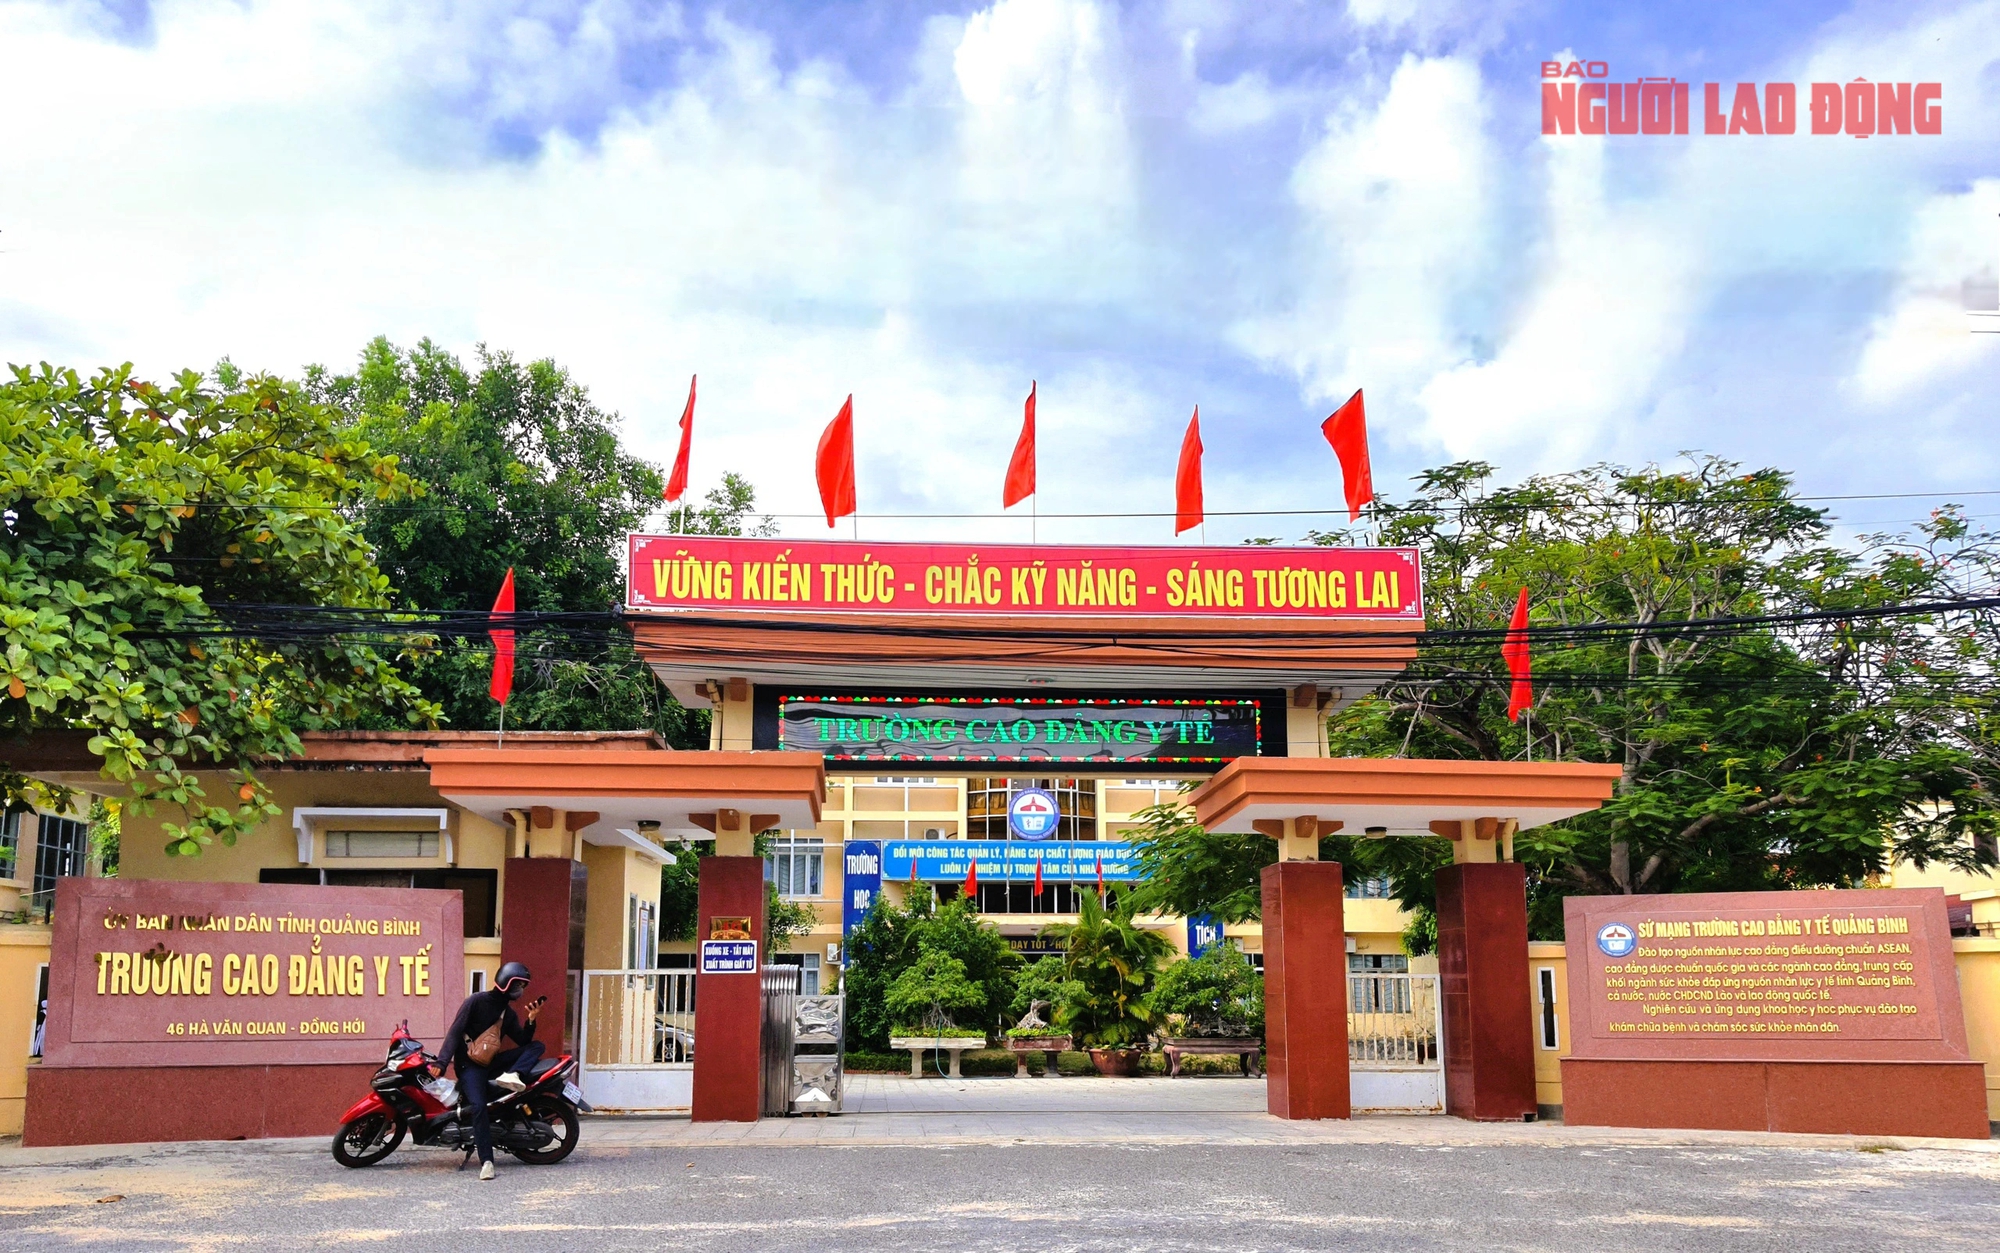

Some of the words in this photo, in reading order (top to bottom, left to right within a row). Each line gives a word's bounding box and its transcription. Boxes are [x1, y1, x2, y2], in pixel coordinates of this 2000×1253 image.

[653, 550, 732, 600] VỮNG
[743, 549, 811, 602] KIẾN
[820, 554, 895, 604] THỨC
[904, 583, 915, 592] -
[925, 554, 1002, 605] CHẮC
[1011, 560, 1048, 606] KỸ
[1057, 560, 1137, 606] NĂNG
[1146, 586, 1156, 594] -
[1166, 561, 1244, 607] SÁNG
[1252, 567, 1346, 608] TƯƠNG
[1356, 571, 1400, 608] LAI
[814, 712, 958, 742] TRƯỜNG
[965, 719, 1036, 743] CAO
[1143, 720, 1166, 744] Y
[909, 845, 924, 858] MỚI
[926, 847, 948, 858] CÔNG
[950, 846, 965, 858] TÁC
[966, 844, 988, 859] QUẢN
[1028, 848, 1044, 858] CAO
[1046, 845, 1067, 858] CHẤT
[1096, 846, 1114, 858] GIÁO
[846, 850, 878, 874] TRƯỜNG
[940, 862, 961, 874] LUÔN
[975, 862, 999, 876] NHIỆM
[1044, 862, 1060, 874] TÂM
[1062, 860, 1078, 874] CỦA
[1080, 862, 1097, 874] NHÀ
[854, 889, 870, 914] HỌC
[136, 913, 174, 930] BAN
[234, 912, 272, 933] DÂN
[277, 912, 316, 934] TỈNH
[319, 912, 378, 935] QUẢNG
[383, 917, 420, 936] BÌNH
[1638, 919, 1654, 938] SỨ
[1656, 922, 1691, 940] MẠNG
[1692, 917, 1738, 937] TRƯỜNG
[1741, 920, 1765, 936] CAO
[1768, 913, 1801, 936] ĐẲNG
[1803, 920, 1812, 935] Y
[1815, 914, 1831, 935] TẾ
[1832, 913, 1875, 935] QUẢNG
[1877, 914, 1908, 934] BÌNH
[1638, 946, 1657, 957] Đào
[1659, 947, 1674, 958] tạo
[1704, 946, 1727, 956] nhân
[1744, 947, 1763, 956] cao
[1764, 942, 1789, 957] đẳng
[1813, 944, 1844, 957] dưỡng
[1845, 941, 1875, 954] chuẩn
[1878, 943, 1912, 955] ASEAN,
[222, 953, 279, 996] CAO
[288, 934, 364, 996] ĐẲNG
[374, 956, 390, 996] Y
[400, 944, 432, 996] TẾ
[1605, 964, 1623, 974] cao
[1625, 960, 1648, 975] đẳng
[1675, 961, 1703, 973] chuẩn
[1705, 961, 1728, 974] quốc
[1730, 962, 1746, 974] gia
[1748, 962, 1759, 972] và
[1761, 962, 1780, 972] các
[1782, 961, 1812, 974] ngành
[1814, 963, 1832, 971] cao
[1834, 958, 1862, 973] đẳng,
[1863, 961, 1890, 973] trung
[1893, 959, 1913, 972] cấp
[1606, 976, 1626, 987] khối
[1628, 977, 1657, 989] ngành
[1659, 977, 1675, 987] sức
[1678, 976, 1700, 987] khỏe
[1702, 977, 1721, 988] đáp
[1723, 977, 1740, 989] ứng
[1774, 976, 1797, 986] nhân
[1800, 976, 1814, 989] lực
[1817, 978, 1822, 988] y
[1825, 974, 1835, 986] tế
[1837, 974, 1854, 986] tỉnh
[1856, 974, 1890, 988] Quảng
[1892, 975, 1916, 987] Bình,
[1608, 990, 1620, 1000] cả
[1622, 990, 1647, 1001] nước,
[1649, 990, 1671, 1000] nước
[1674, 991, 1713, 1000] CHDCND
[1715, 990, 1732, 1000] Lào
[1735, 990, 1746, 1000] và
[1749, 990, 1764, 1000] lao
[1766, 990, 1790, 1002] động
[1793, 989, 1817, 1002] quốc
[1820, 989, 1832, 1000] tế.
[1643, 1004, 1676, 1016] Nghiên
[1679, 1004, 1696, 1014] cứu
[1700, 1004, 1712, 1014] và
[1715, 1004, 1733, 1016] ứng
[1737, 1004, 1760, 1016] dụng
[1763, 1004, 1787, 1014] khoa
[1789, 1004, 1807, 1016] học
[1810, 1006, 1815, 1016] y
[1838, 1004, 1862, 1016] phục
[1864, 1006, 1876, 1016] vụ
[1878, 1002, 1898, 1014] đào
[1900, 1004, 1917, 1016] tạo
[166, 1022, 184, 1035] 46
[188, 1019, 209, 1034] HÀ
[213, 1019, 242, 1034] VĂN
[246, 1022, 286, 1035] QUAN
[300, 1016, 339, 1034] ĐỒNG
[342, 1018, 365, 1033] HỚI
[1610, 1022, 1635, 1032] khám
[1638, 1022, 1660, 1032] chữa
[1663, 1022, 1686, 1034] bệnh
[1689, 1022, 1700, 1032] và
[1702, 1022, 1728, 1032] chăm
[1731, 1022, 1748, 1032] sóc
[1750, 1022, 1767, 1032] sức
[1768, 1020, 1792, 1032] khỏe
[1794, 1022, 1818, 1032] nhân
[1820, 1022, 1841, 1032] dân.
